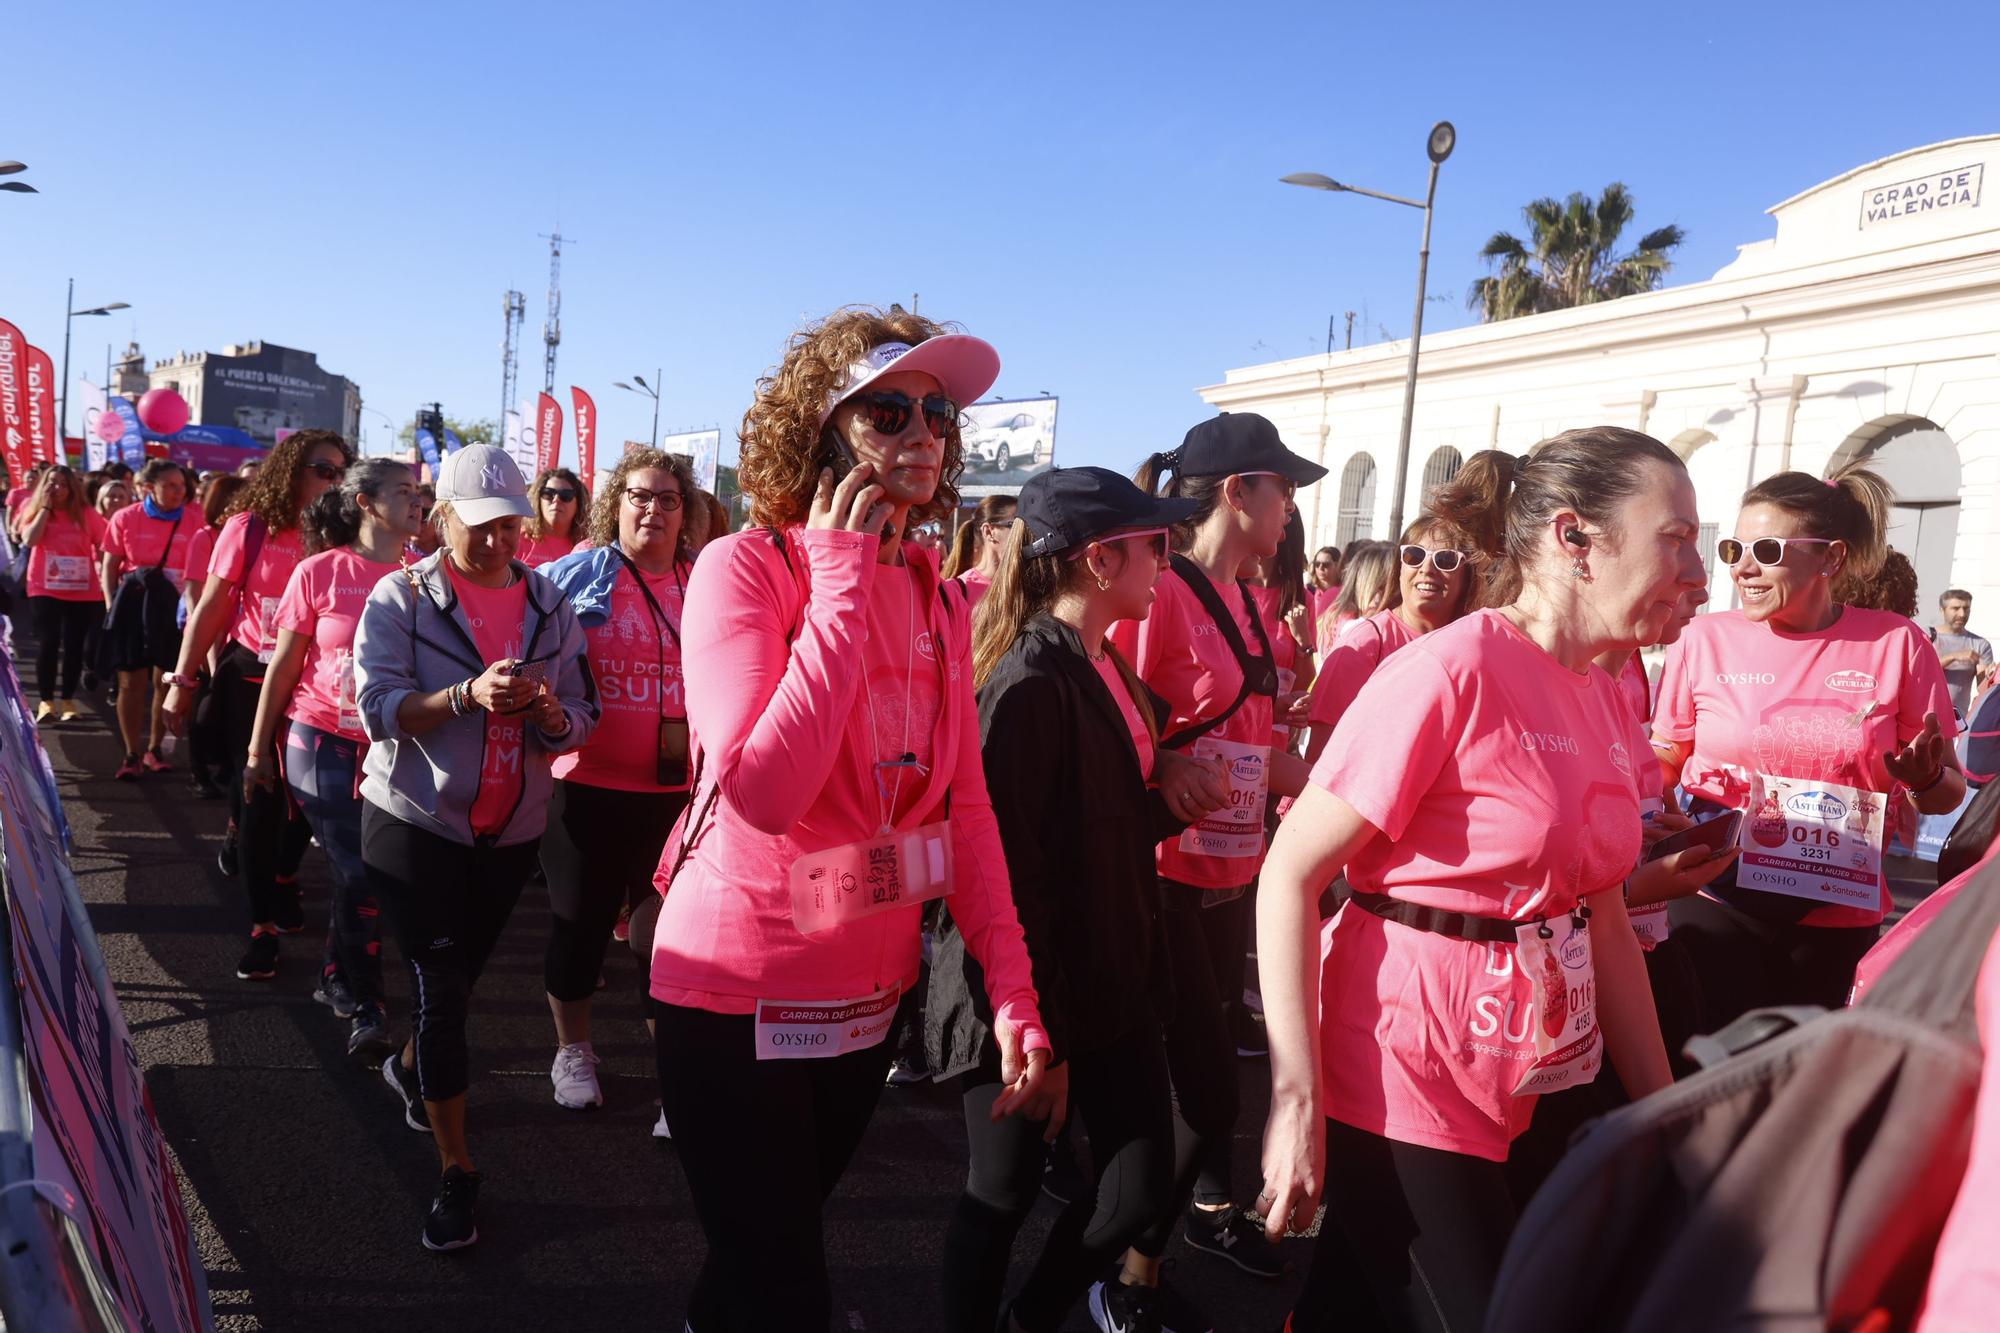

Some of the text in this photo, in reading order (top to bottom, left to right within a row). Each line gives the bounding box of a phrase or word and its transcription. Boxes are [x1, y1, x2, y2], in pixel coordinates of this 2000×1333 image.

[1873, 172, 1970, 205] GRAO DE
[1867, 189, 1971, 222] VALENCIA
[227, 369, 265, 382] PUERTO
[1192, 623, 1218, 637] OYS
[599, 659, 682, 678] TU DORS
[1716, 672, 1776, 685] OYSHO
[601, 675, 680, 705] SUM
[1519, 730, 1580, 755] OYSHO
[1231, 789, 1256, 806] 016
[1232, 808, 1249, 820] 4021
[1193, 836, 1228, 849] OYSHO
[1791, 826, 1841, 848] 016
[1800, 847, 1832, 861] 3231
[1758, 857, 1797, 870] CARRERA
[1799, 863, 1811, 871] DE
[1812, 865, 1824, 874] LA
[1825, 867, 1850, 879] MUJER
[1752, 871, 1798, 888] OYSHO
[1832, 885, 1870, 900] Santander
[779, 1010, 830, 1021] CARRERA
[831, 1010, 845, 1020] DE
[845, 1006, 855, 1017] LA
[772, 1032, 827, 1046] OYSHO
